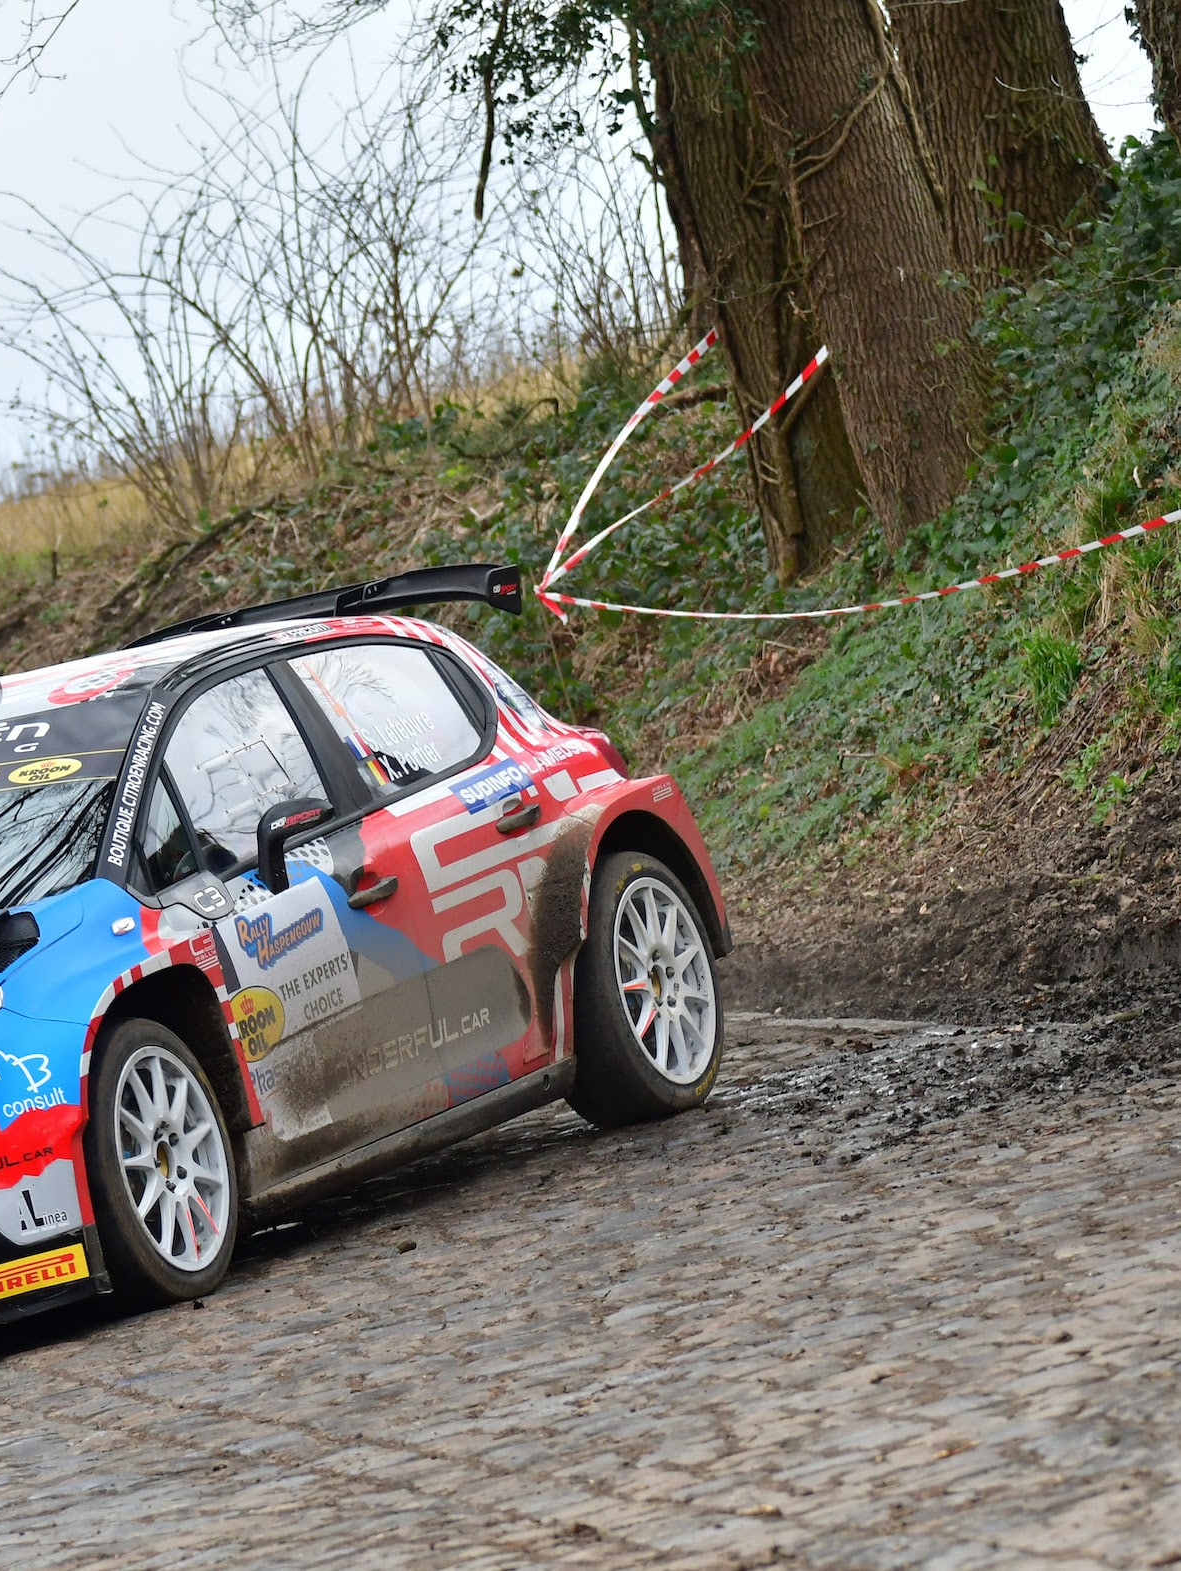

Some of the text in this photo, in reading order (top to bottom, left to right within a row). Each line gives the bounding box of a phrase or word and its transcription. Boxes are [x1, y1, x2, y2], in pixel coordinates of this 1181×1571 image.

[18, 764, 72, 777] KROON
[378, 741, 441, 781] X. Portier
[28, 773, 50, 782] OIL
[108, 702, 166, 867] BOUTIQUE.CITROENRACING.COM
[194, 886, 226, 912] C3
[189, 929, 216, 957] C3
[279, 978, 301, 1002] THE
[303, 987, 345, 1021] CHOICE
[247, 1034, 268, 1057] OIL
[2, 1086, 68, 1118] consult
